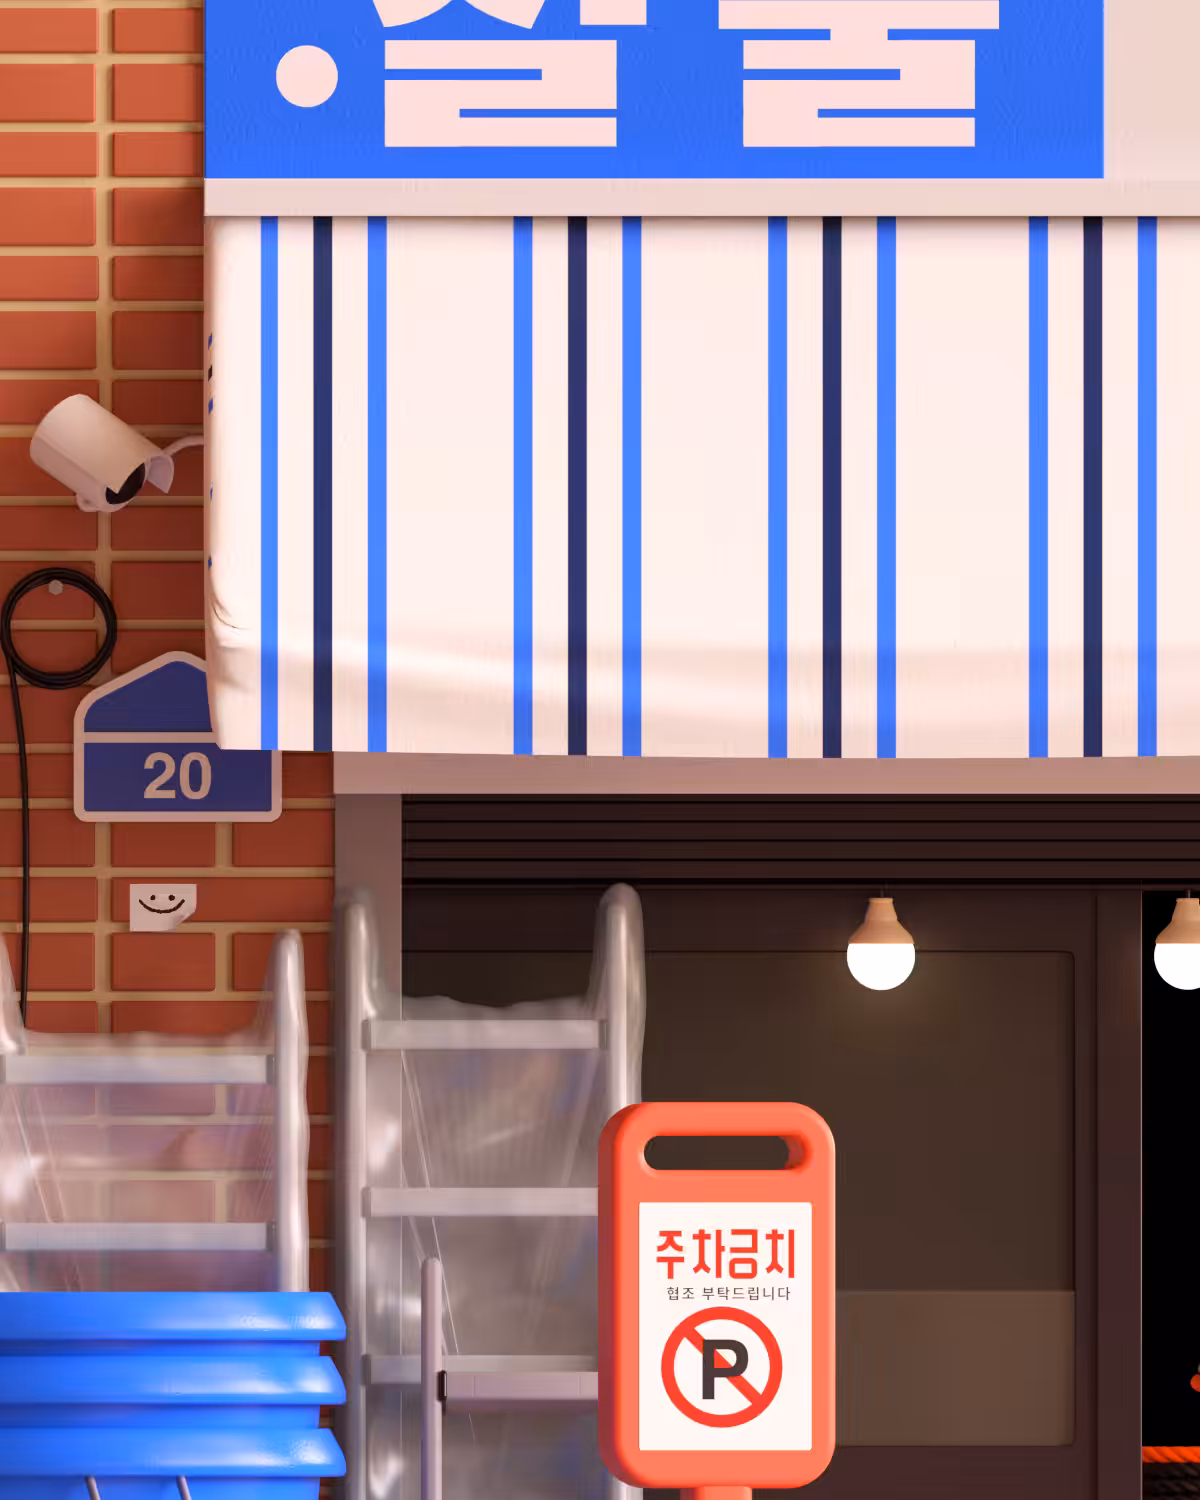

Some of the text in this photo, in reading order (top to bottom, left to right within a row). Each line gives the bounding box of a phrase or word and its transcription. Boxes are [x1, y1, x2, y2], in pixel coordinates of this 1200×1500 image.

[144, 752, 212, 799] 20
[667, 1286, 791, 1301] 협조 부탁드립니다
